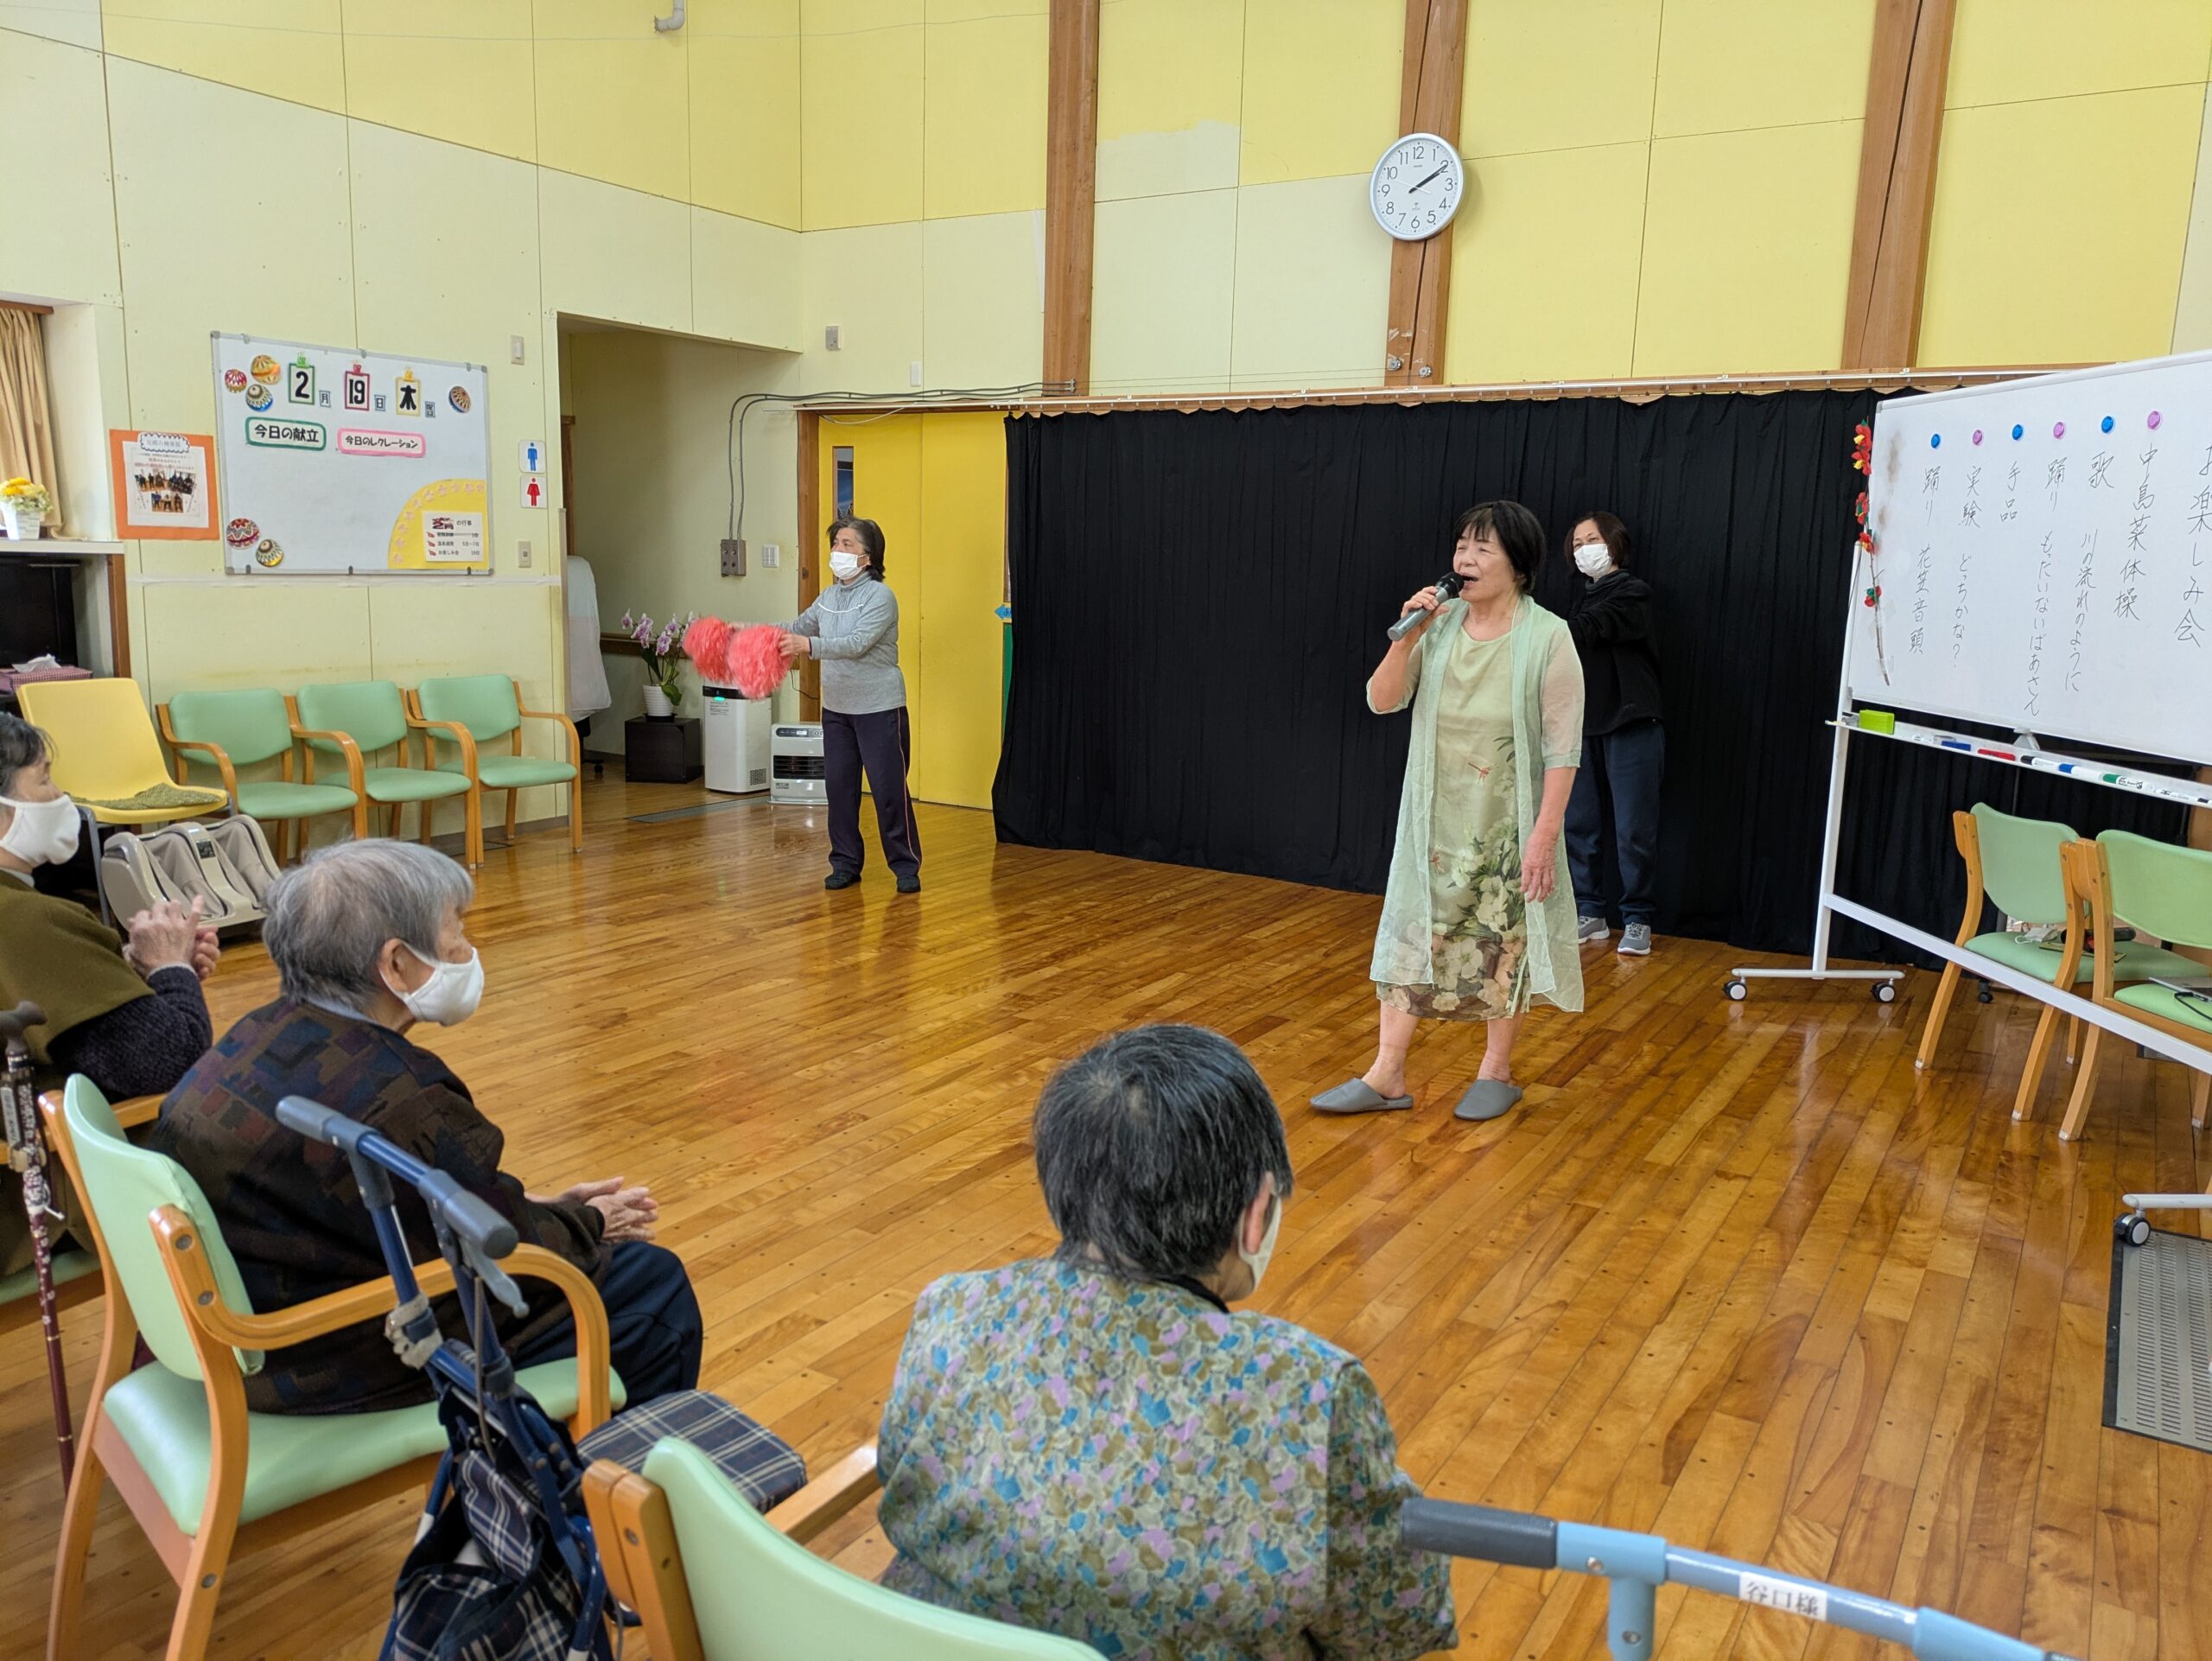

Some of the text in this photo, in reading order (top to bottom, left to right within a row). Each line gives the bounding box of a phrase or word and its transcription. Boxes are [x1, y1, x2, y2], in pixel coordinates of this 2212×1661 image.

[1400, 151, 1408, 165] 11
[1413, 145, 1424, 160] 12
[1387, 166, 1398, 180] 10
[1440, 160, 1449, 173] 2
[1381, 184, 1390, 197] 9
[1445, 177, 1453, 191] 3
[1386, 201, 1395, 214] 8
[1439, 197, 1447, 209] 4
[1398, 213, 1407, 226] 7
[1411, 216, 1420, 229] 6
[1427, 210, 1436, 223] 5
[295, 371, 310, 399] 2
[321, 392, 330, 404] 月
[348, 379, 365, 404] 19
[375, 398, 384, 410] 日
[399, 385, 417, 410] 木
[254, 423, 320, 442] 今日の献立
[345, 435, 418, 449] 今日のレクレーション
[2000, 460, 2021, 523] 手品
[2113, 442, 2158, 621] 中島菜体操
[1909, 465, 1942, 655] 踊り 花笠音頭
[1953, 465, 1983, 669] 実験 どっちかな？
[2065, 451, 2114, 691] 歌 川の流れのように
[2024, 456, 2067, 717] 踊り もったいないばあさん
[1747, 1581, 1819, 1616] 谷口様
